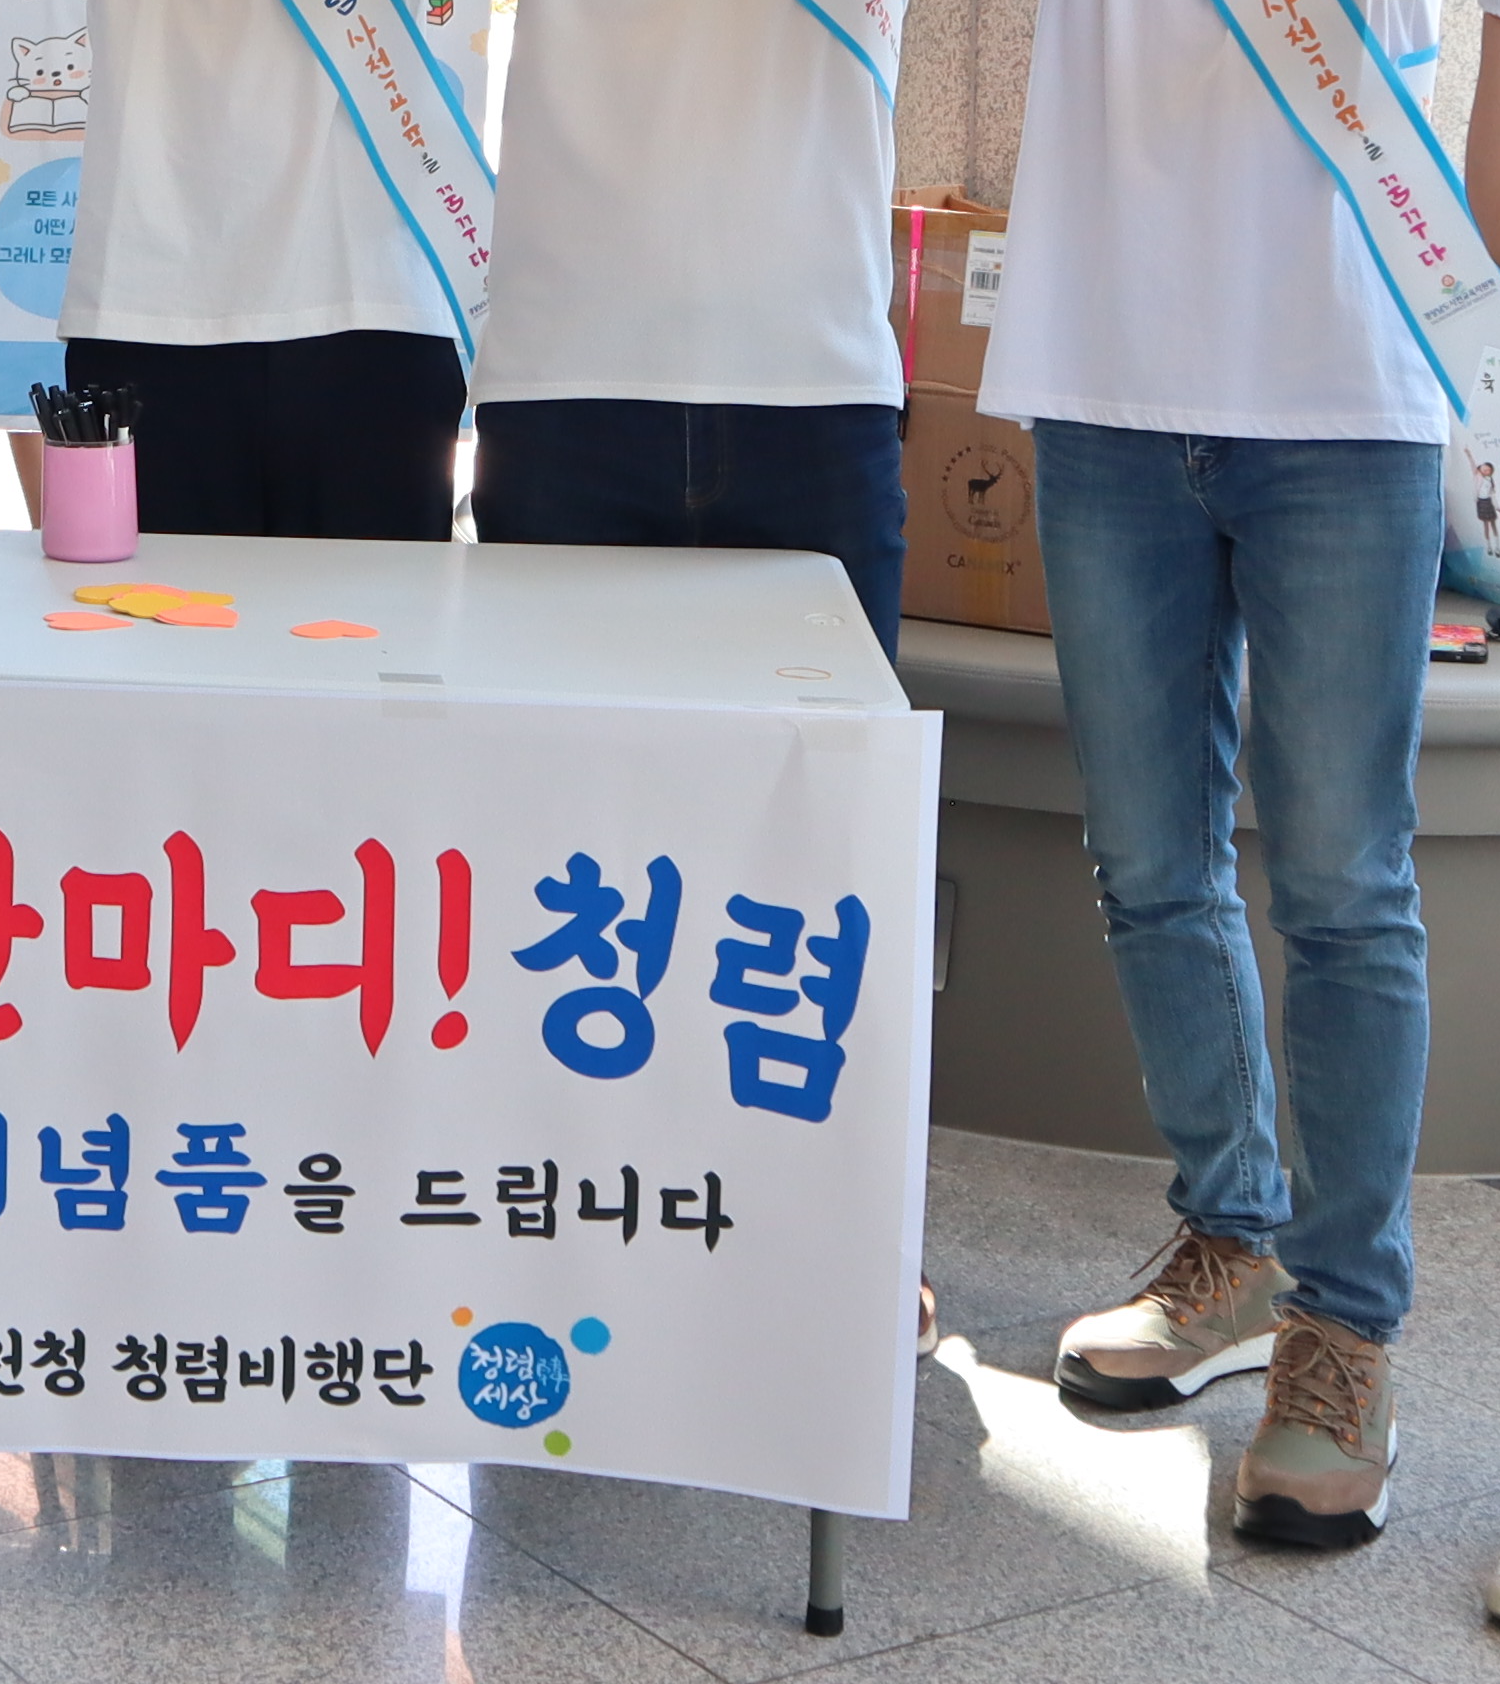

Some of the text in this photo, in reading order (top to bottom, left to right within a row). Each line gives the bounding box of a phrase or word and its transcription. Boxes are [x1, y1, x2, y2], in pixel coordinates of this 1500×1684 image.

[346, 14, 442, 174] 사천교육을
[435, 183, 490, 268] 꿈꾸다
[25, 190, 57, 207] 모든
[34, 218, 66, 236] 어떤
[1378, 173, 1448, 267] 꿈꾸다
[511, 851, 871, 1123] 청렴
[400, 1159, 734, 1253] 드립니다
[112, 1333, 434, 1406] 청렴비행단
